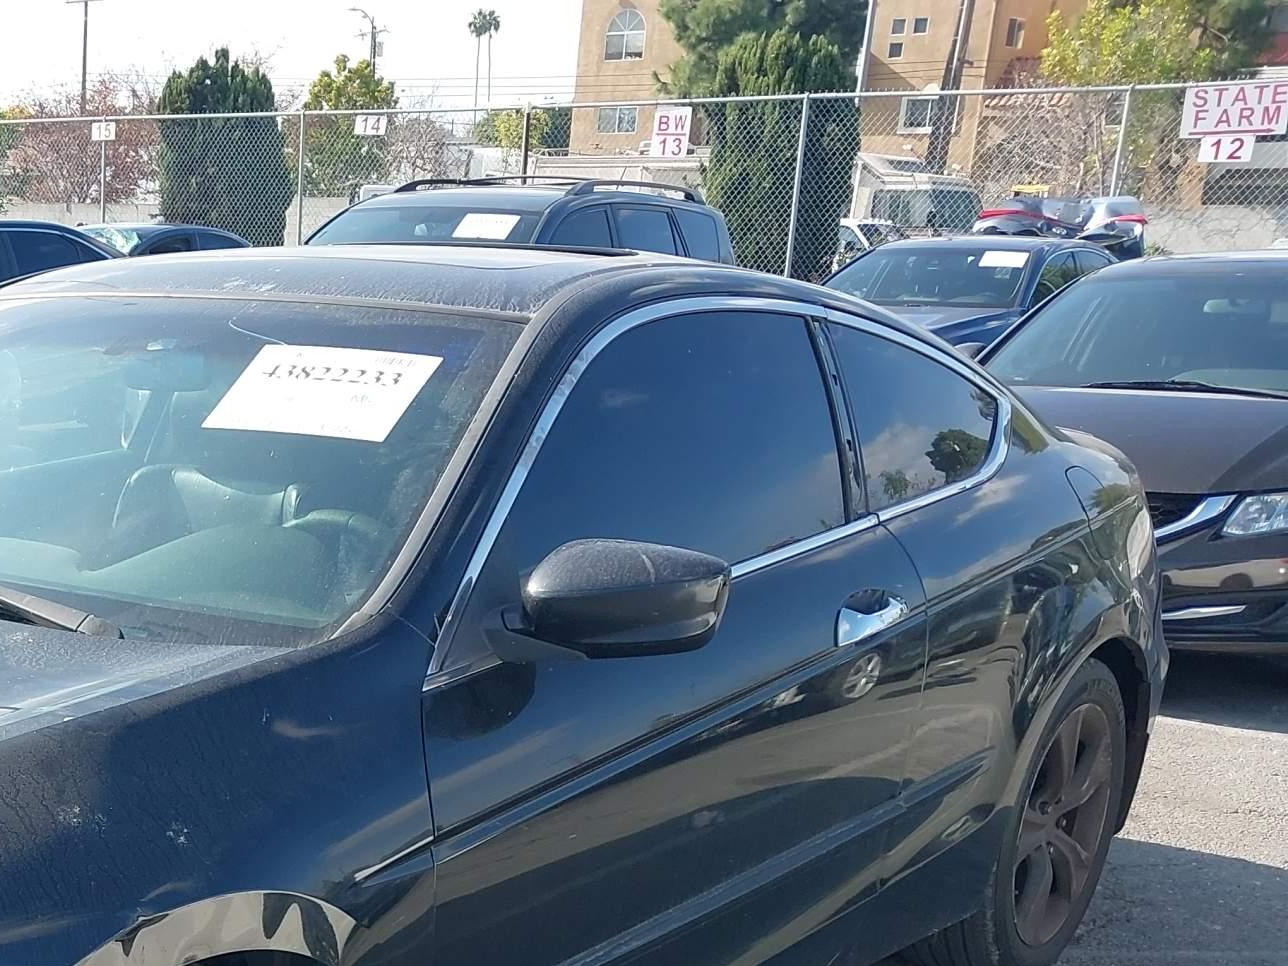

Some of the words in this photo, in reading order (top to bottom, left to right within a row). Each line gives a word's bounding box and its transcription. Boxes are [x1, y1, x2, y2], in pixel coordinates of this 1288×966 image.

[1193, 84, 1288, 108] STATE
[361, 116, 380, 133] 14
[658, 114, 687, 131] BW
[1193, 105, 1282, 128] FARM
[97, 123, 111, 138] 15
[659, 137, 682, 156] 13
[1210, 137, 1244, 160] 12
[262, 364, 403, 386] 43822233
